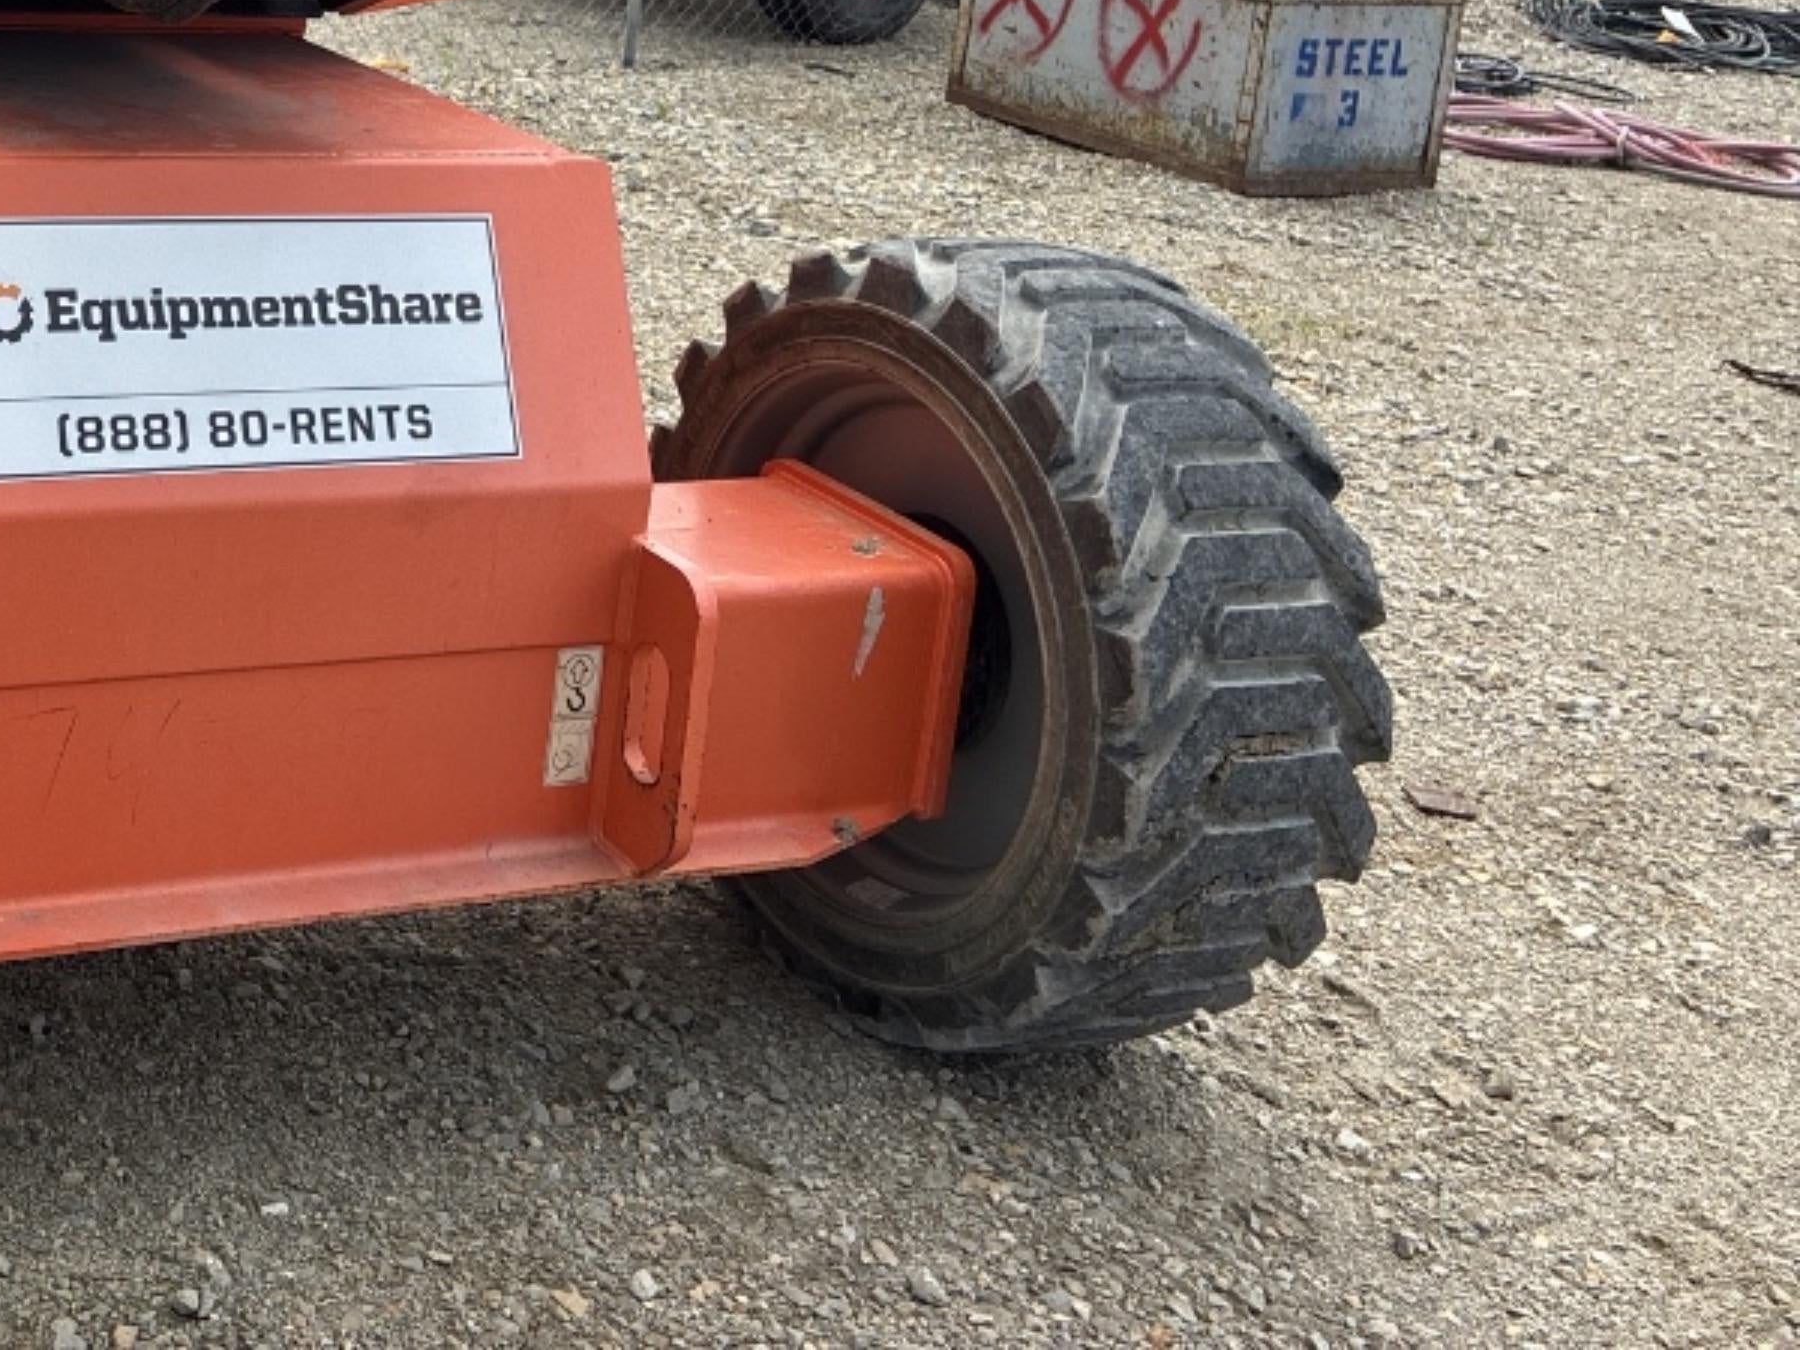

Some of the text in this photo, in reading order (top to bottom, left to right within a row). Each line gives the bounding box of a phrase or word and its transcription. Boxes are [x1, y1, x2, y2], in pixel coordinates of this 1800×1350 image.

[1294, 37, 1409, 79] STEEL
[1337, 88, 1361, 128] 3
[44, 284, 484, 342] EquipmentShare
[57, 403, 434, 456] (888) 80-RENTS
